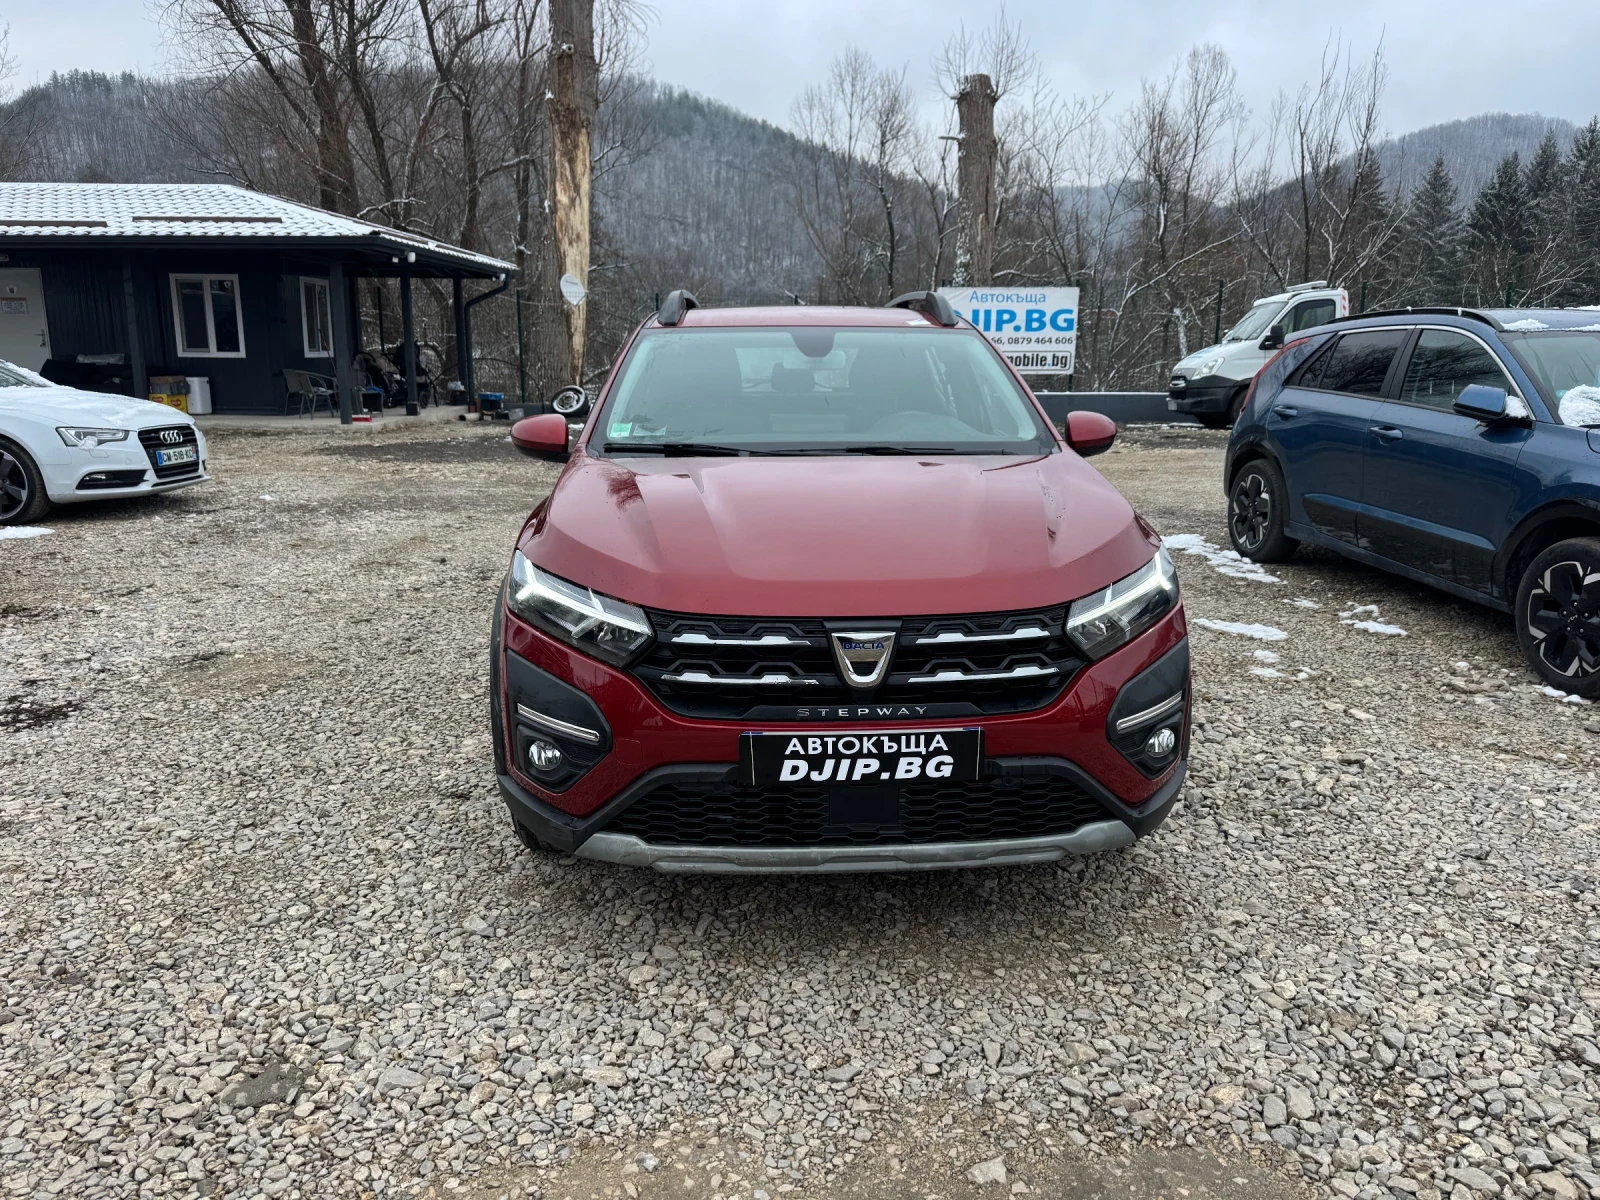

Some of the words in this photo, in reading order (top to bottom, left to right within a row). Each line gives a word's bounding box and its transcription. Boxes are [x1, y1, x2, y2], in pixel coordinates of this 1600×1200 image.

[969, 290, 1046, 305] Автокъща
[953, 308, 1075, 332] JIP.BG
[1007, 336, 1032, 345] 0879
[1034, 336, 1053, 345] 464
[1054, 336, 1073, 345] 606
[843, 642, 885, 650] DACIA
[797, 706, 927, 717] STEPWAY
[785, 734, 949, 755] АВТОКЪЩА
[779, 754, 954, 782] DJIP.BG
